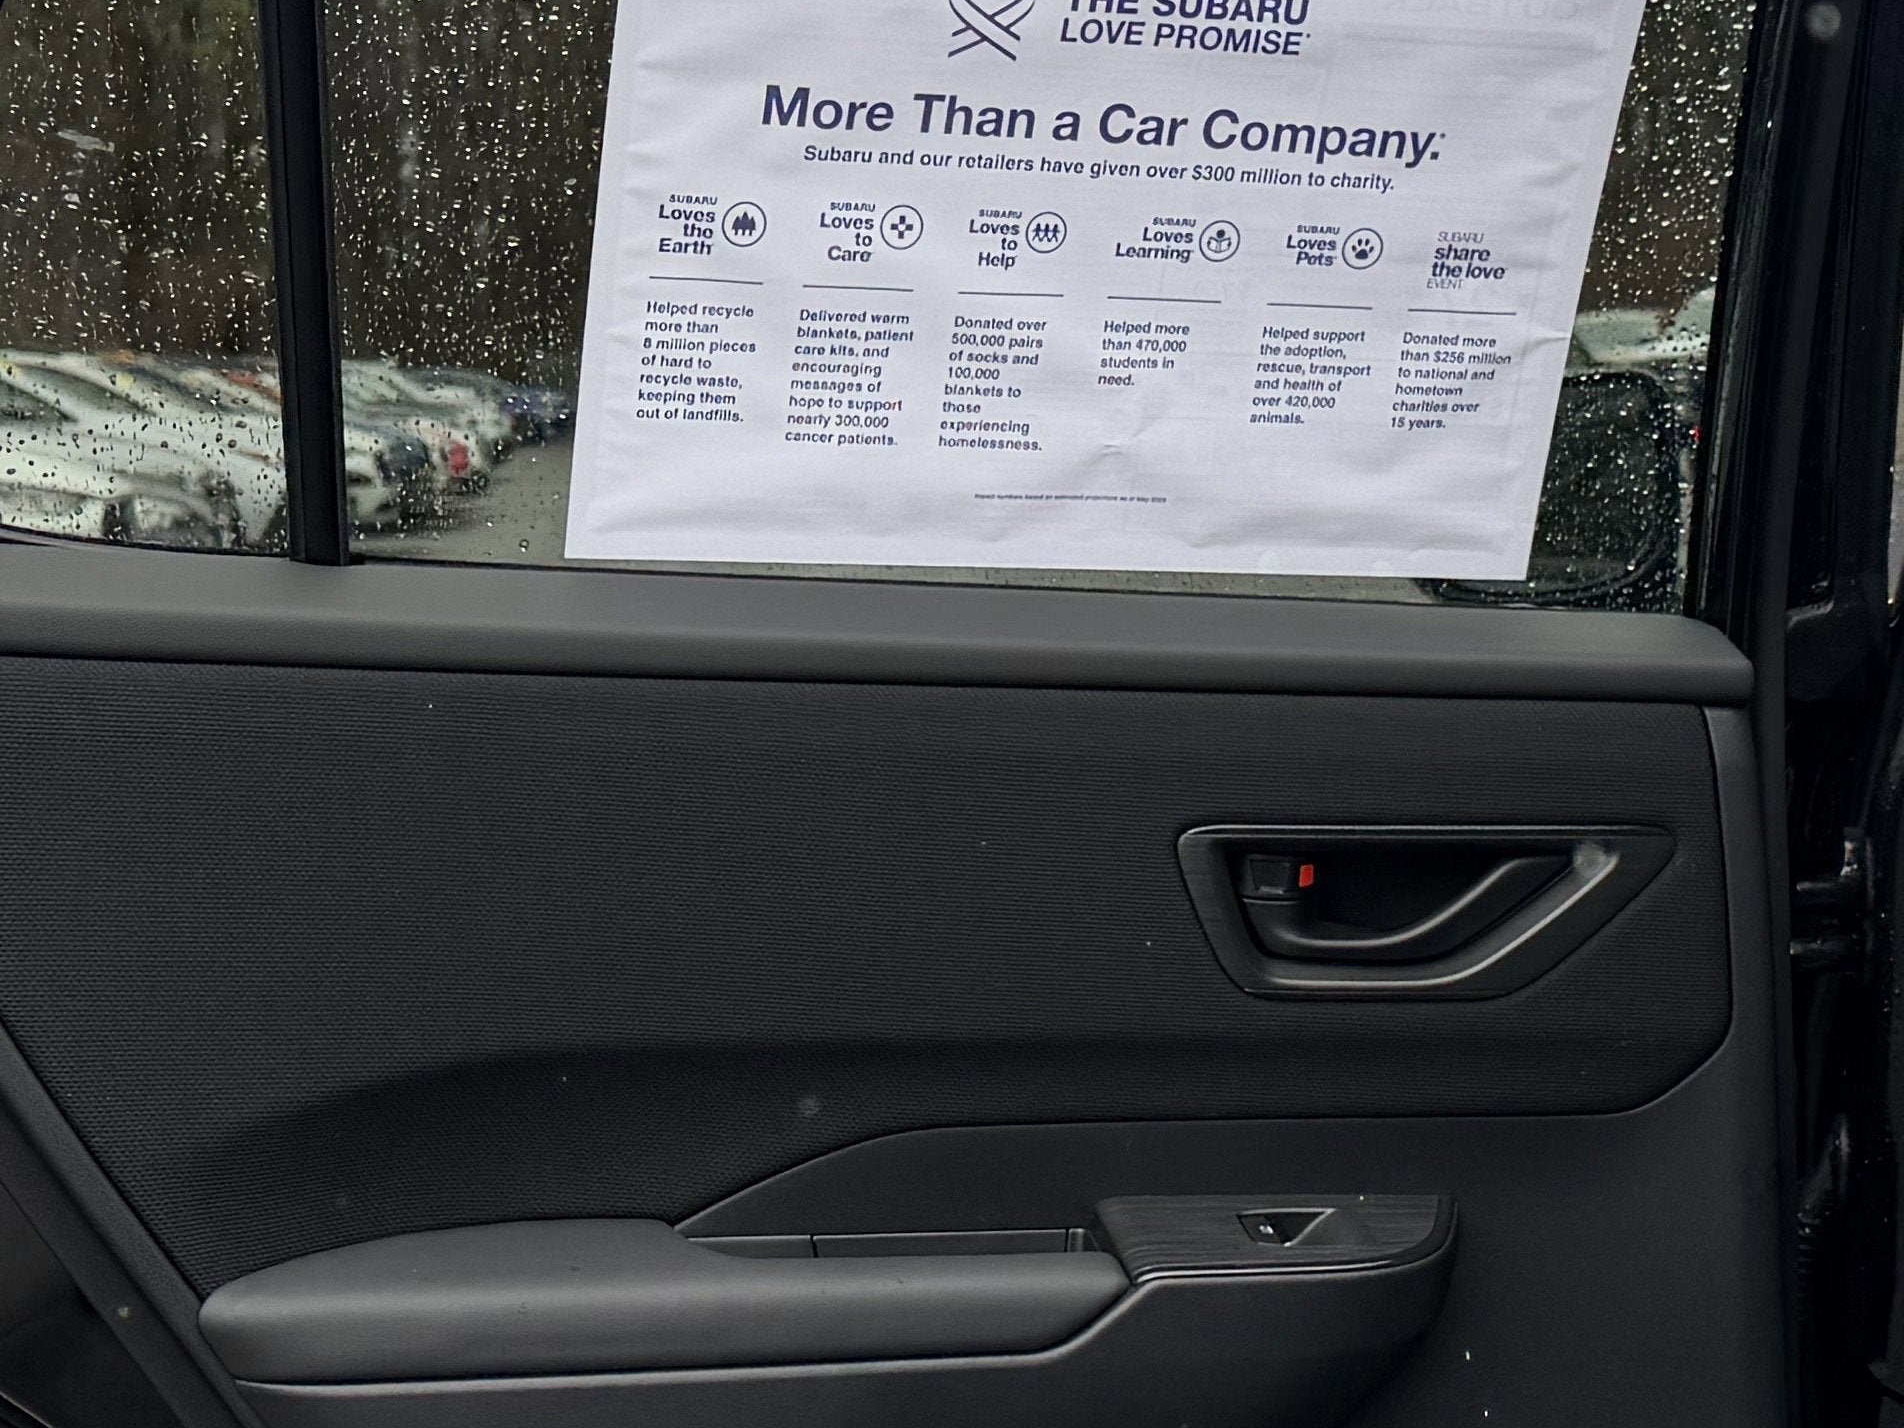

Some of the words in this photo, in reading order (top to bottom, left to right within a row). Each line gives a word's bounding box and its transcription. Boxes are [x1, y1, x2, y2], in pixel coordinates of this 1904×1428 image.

[1060, 18, 1146, 45] LOVE
[762, 84, 894, 132] More
[913, 93, 1036, 139] Than
[1051, 110, 1081, 142] a
[1098, 103, 1189, 147] Car
[804, 145, 872, 163] Subaru
[879, 149, 914, 165] and
[920, 153, 953, 167] our
[958, 154, 1034, 172] retailers
[1040, 157, 1084, 174] have
[1090, 160, 1140, 180] given
[1146, 165, 1188, 180] over
[1192, 164, 1235, 183] $300
[1240, 168, 1302, 187] million
[1308, 172, 1326, 187] to
[1330, 172, 1395, 195] charity.
[669, 194, 718, 205] SUBARU
[658, 205, 716, 222] Loves
[820, 213, 874, 229] Loves
[683, 223, 713, 238] the
[969, 220, 1020, 236] Loves
[1142, 228, 1194, 243] Loves
[658, 238, 713, 255] Earth
[855, 233, 873, 247] to
[1001, 237, 1018, 251] to
[1286, 235, 1337, 251] Loves
[828, 247, 873, 262] Care
[1115, 244, 1193, 263] Learning
[1296, 252, 1334, 266] Pets
[1434, 245, 1491, 261] share
[978, 253, 1016, 270] Help
[1432, 262, 1463, 278] the
[1465, 263, 1506, 280] love
[646, 301, 698, 318] Helped
[702, 306, 754, 320] recycle
[800, 310, 866, 323] Delivered
[870, 314, 909, 324] warm
[645, 321, 682, 333] more
[687, 322, 719, 333] than
[954, 317, 1013, 330] Donated
[1017, 320, 1047, 331] over
[1104, 321, 1151, 337] Helped
[1154, 324, 1190, 336] more
[797, 327, 861, 340] blankets,
[864, 330, 913, 343] patient
[951, 333, 1005, 347] 500,000
[1009, 335, 1043, 350] pairs
[1262, 327, 1309, 342] Helped
[1313, 331, 1365, 343] support
[1403, 332, 1459, 347] Donated
[1462, 338, 1496, 348] more
[656, 339, 704, 352] million
[710, 341, 756, 354] pieces
[794, 346, 825, 356] care
[830, 345, 858, 358] kits,
[862, 347, 889, 358] and
[1102, 339, 1131, 351] than
[1135, 340, 1187, 354] 470,000
[1260, 344, 1281, 357] the
[1284, 346, 1346, 360] adoption,
[641, 356, 657, 367] of
[660, 356, 693, 369] hard
[697, 357, 712, 369] to
[949, 351, 963, 363] of
[967, 351, 1008, 364] socks
[1012, 353, 1039, 365] and
[1100, 356, 1158, 369] students
[1162, 358, 1174, 369] in
[1401, 350, 1429, 363] than
[1433, 352, 1464, 364] $256
[1468, 353, 1511, 365] million
[792, 362, 882, 378] encouraging
[948, 368, 1000, 381] 100,000
[1257, 363, 1306, 376] rescue,
[1309, 364, 1371, 378] transport
[1398, 368, 1411, 379] to
[1415, 367, 1468, 381] national
[1471, 370, 1495, 381] and
[640, 374, 692, 388] recycle
[696, 377, 742, 389] waste,
[790, 380, 862, 394] messages
[867, 381, 882, 393] of
[1098, 374, 1135, 387] need.
[1254, 379, 1280, 390] and
[1283, 379, 1324, 392] health
[1328, 381, 1341, 392] of
[638, 389, 695, 405] keeping
[700, 392, 736, 405] them
[945, 384, 1003, 399] blankets
[1007, 387, 1021, 399] to
[1395, 385, 1462, 396] hometown
[789, 396, 824, 409] hope
[828, 397, 843, 409] to
[847, 400, 902, 413] support
[1252, 397, 1281, 407] over
[1285, 395, 1335, 409] 420,000
[1392, 400, 1448, 413] charities
[1451, 402, 1480, 413] over
[637, 407, 660, 419] out
[664, 407, 679, 420] of
[683, 407, 745, 423] landfills.
[787, 414, 830, 429] nearly
[834, 415, 889, 429] 300,000
[1250, 412, 1304, 424] animals.
[940, 419, 1030, 436] experiencing
[1391, 417, 1405, 428] 15
[1408, 418, 1446, 430] years.
[785, 432, 834, 443] cancer
[837, 433, 898, 446] patients.
[938, 436, 1043, 452] homelessness.
